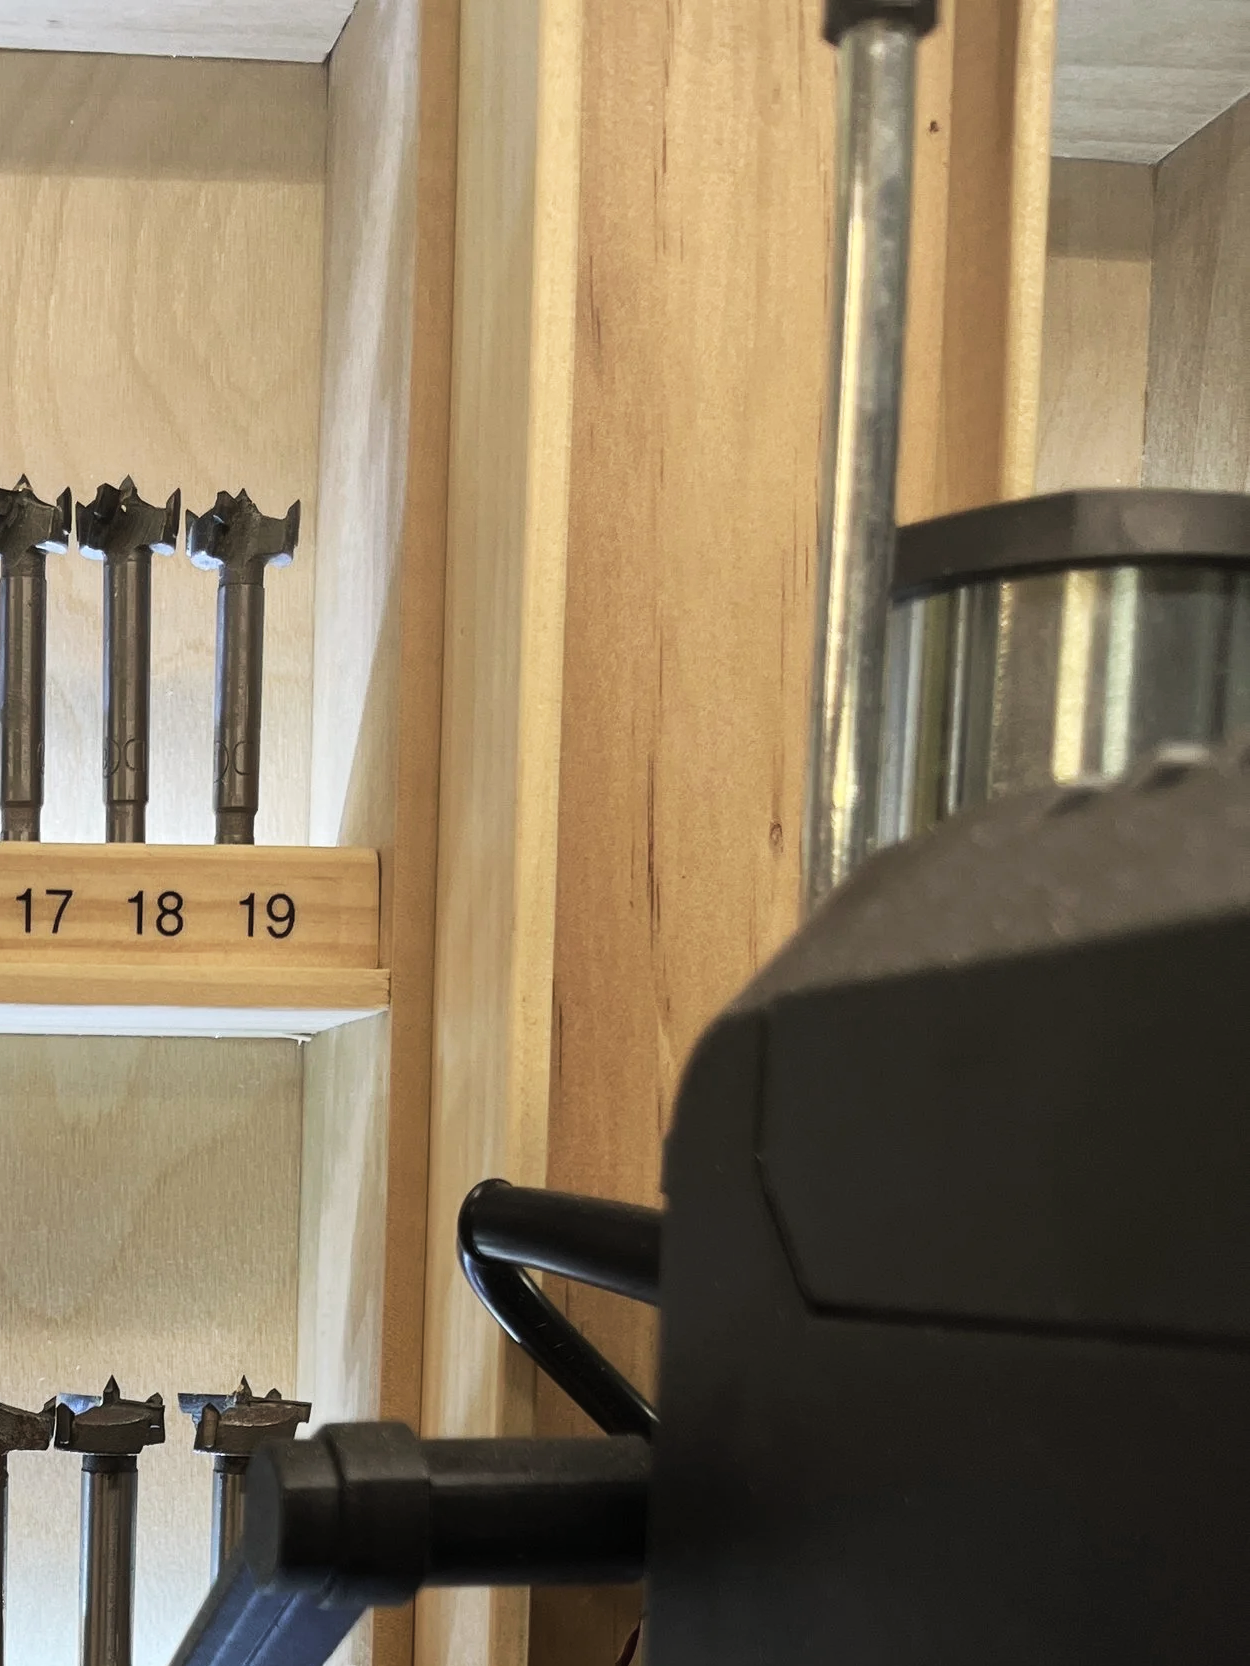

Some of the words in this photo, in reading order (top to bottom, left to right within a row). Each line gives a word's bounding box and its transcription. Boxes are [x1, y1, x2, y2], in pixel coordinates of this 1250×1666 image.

[16, 888, 74, 934] 17
[128, 891, 184, 937] 18
[239, 893, 296, 940] 19
